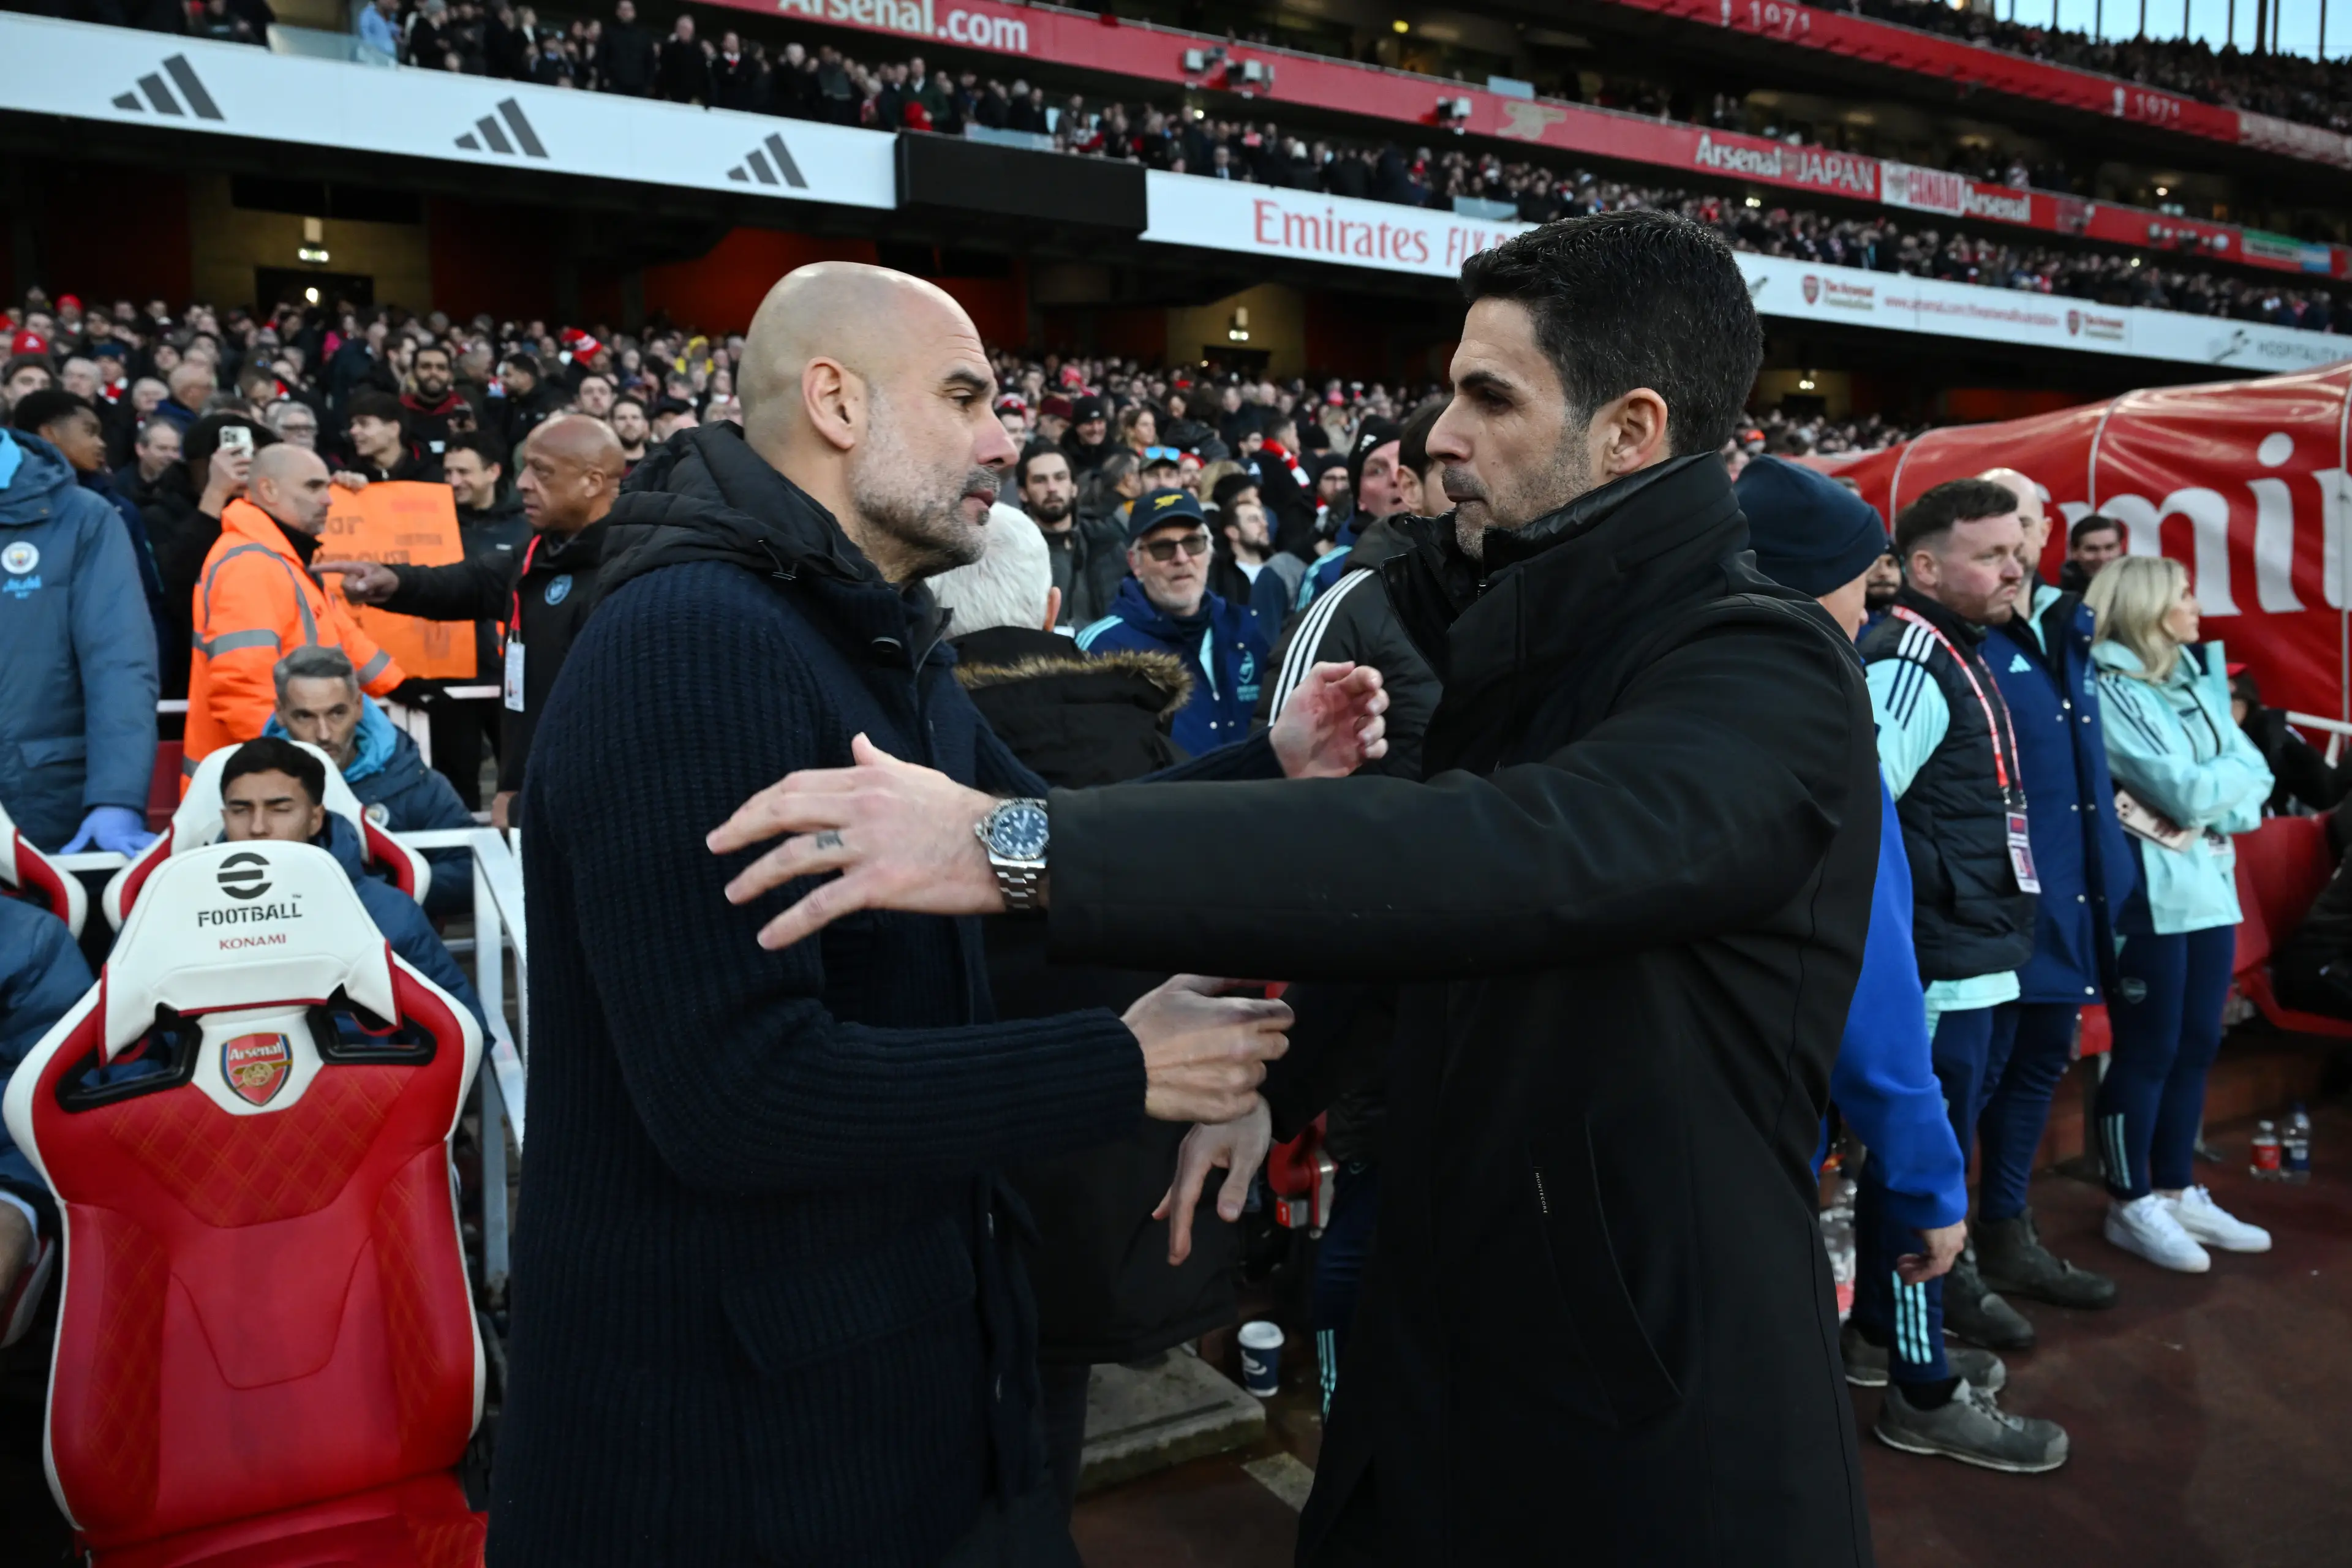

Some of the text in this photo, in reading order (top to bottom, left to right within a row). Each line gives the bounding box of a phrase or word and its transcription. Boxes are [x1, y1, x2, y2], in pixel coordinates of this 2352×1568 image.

[778, 0, 1028, 52] rsenal.com
[1695, 132, 1874, 194] Arsenal JAPAN
[1253, 199, 1429, 263] Emirates
[197, 902, 303, 928] FOOTBALL
[219, 933, 287, 950] KONAMI
[229, 1041, 283, 1061] Arsenal
[1535, 1172, 1548, 1213] MONTECORE
